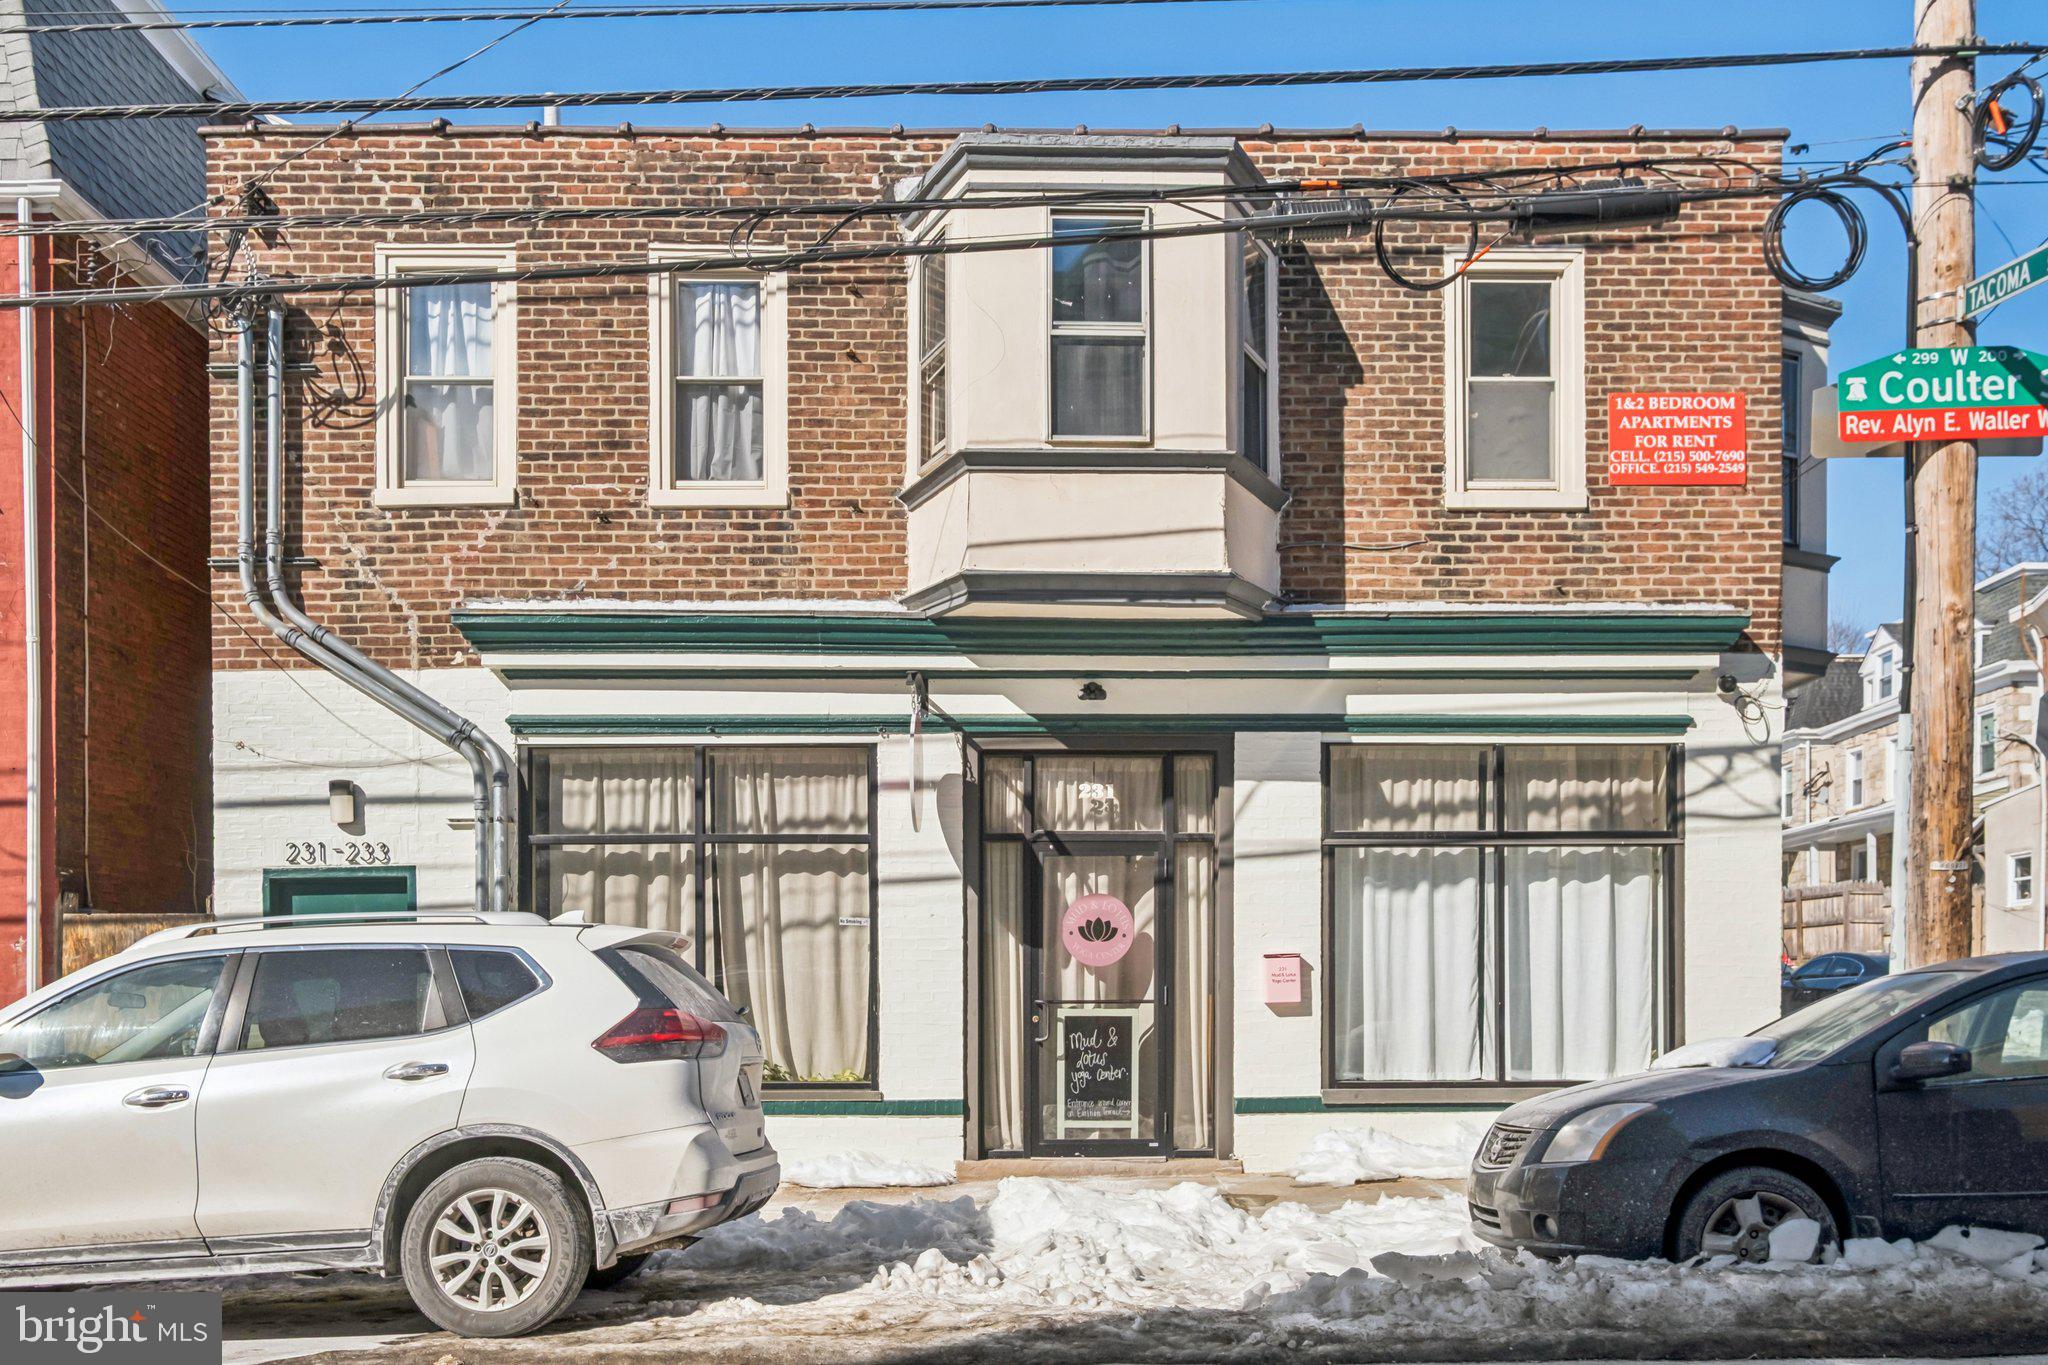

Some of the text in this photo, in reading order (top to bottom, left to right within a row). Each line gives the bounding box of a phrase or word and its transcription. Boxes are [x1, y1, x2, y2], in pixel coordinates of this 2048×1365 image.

[1969, 261, 2031, 311] TACOMA
[1912, 349, 2007, 366] 299 W 200
[1879, 370, 2022, 404] Coulter
[1616, 397, 1736, 410] 1&2 BEDROOM
[1620, 416, 1733, 429] APARTMENTS
[1846, 415, 1885, 435] Rev.
[1893, 412, 1936, 438] Alyn
[1944, 412, 1961, 431] E.
[1969, 410, 2031, 431] Waller
[1635, 435, 1717, 448] FOR RENT
[1654, 451, 1686, 463] (215)
[1690, 451, 1745, 462] 500-7690
[1664, 463, 1692, 474] (215)
[1696, 463, 1745, 474] 549-2549
[1079, 784, 1114, 799] 231
[1070, 1027, 1119, 1050] Mud &
